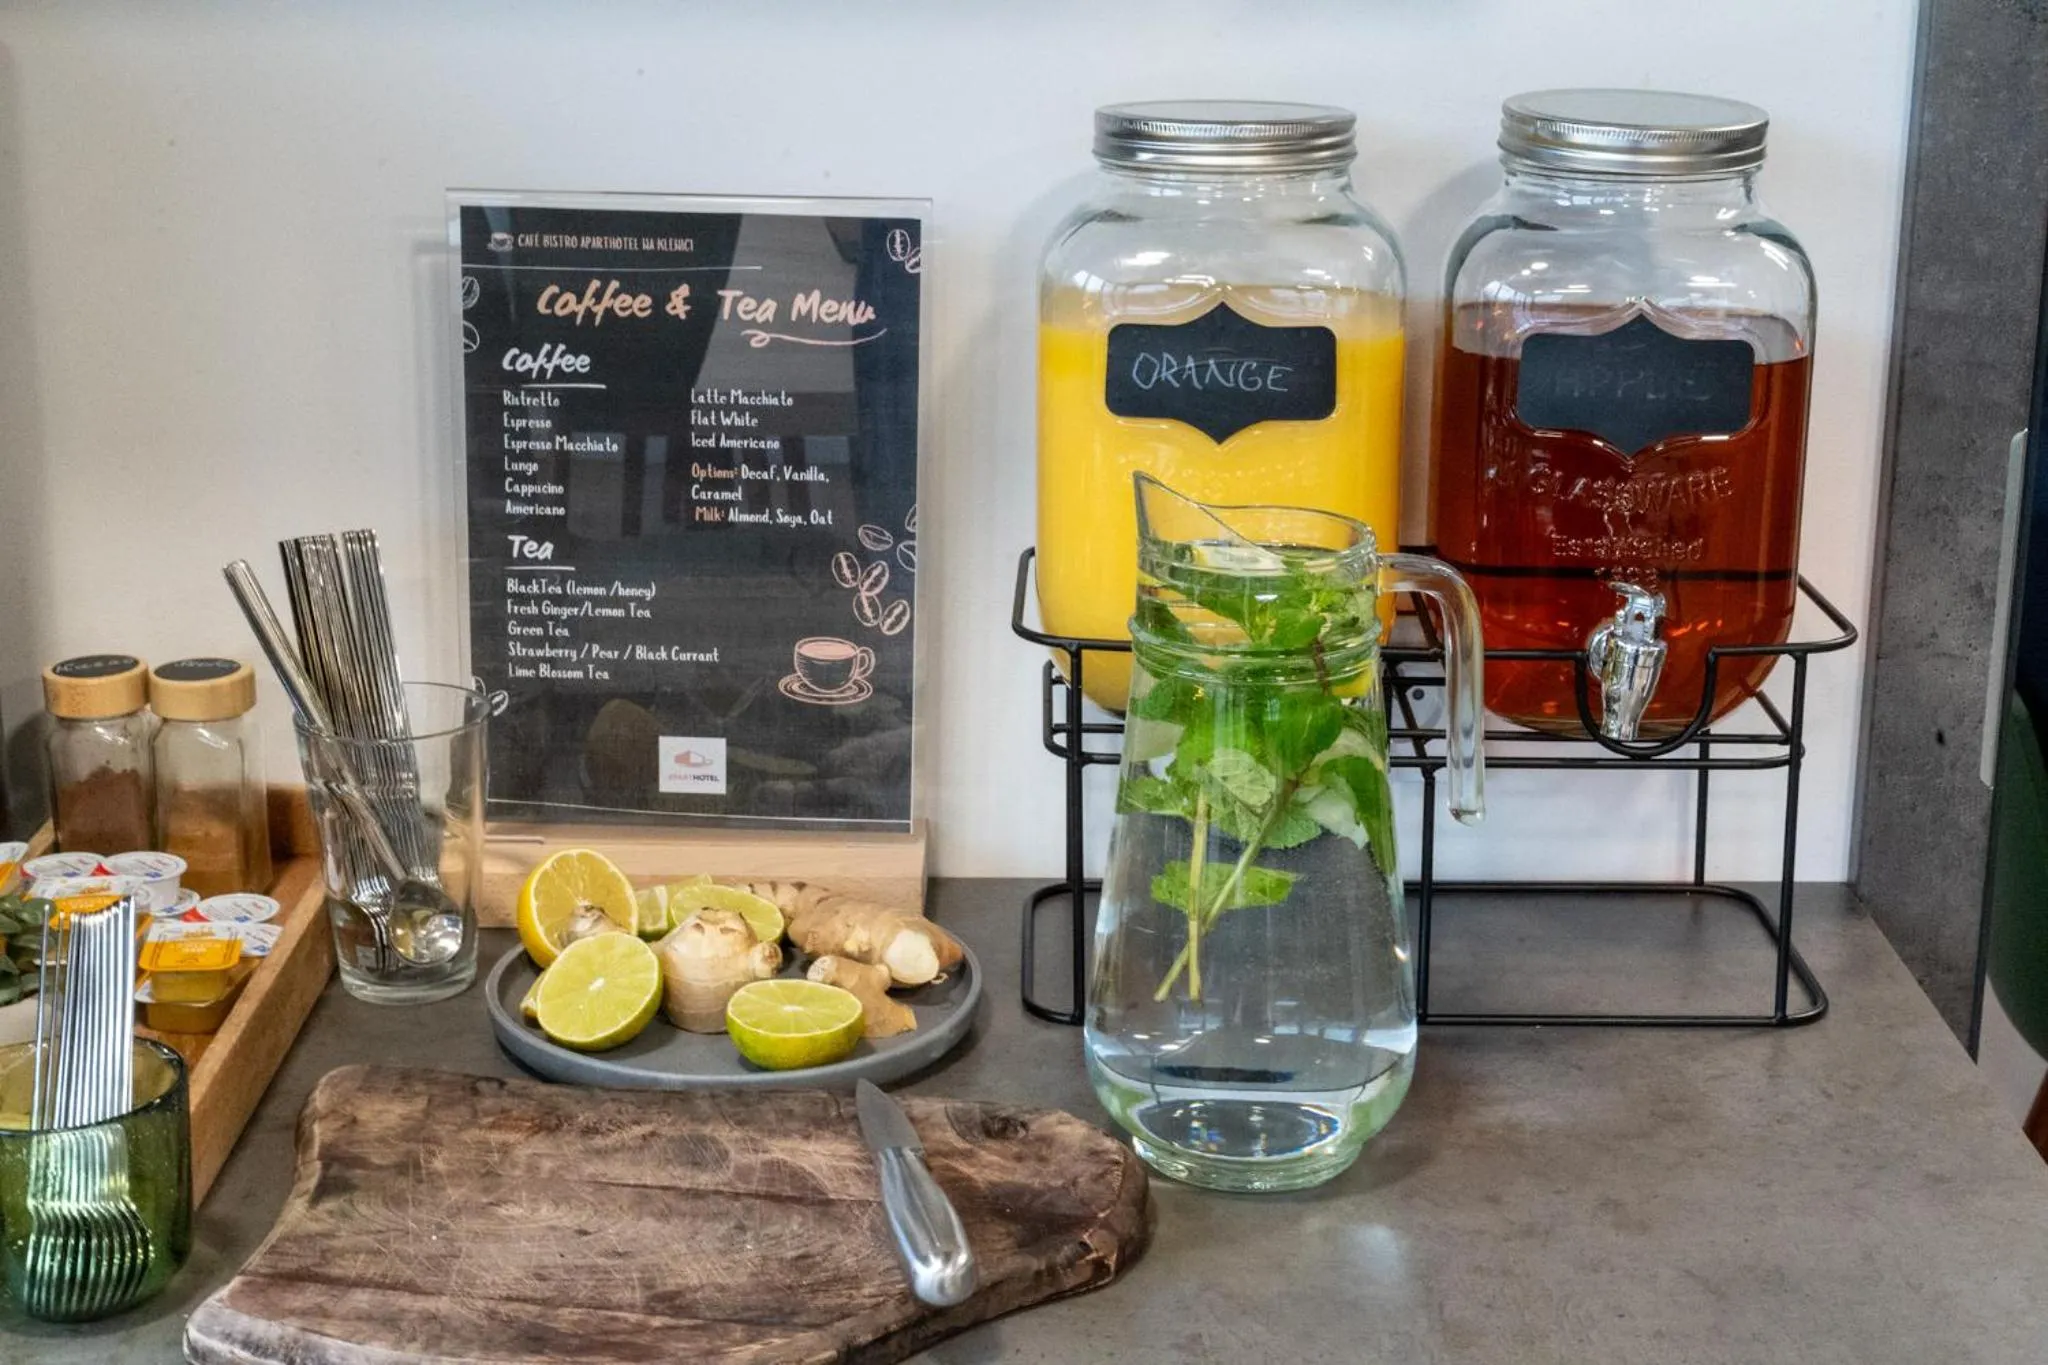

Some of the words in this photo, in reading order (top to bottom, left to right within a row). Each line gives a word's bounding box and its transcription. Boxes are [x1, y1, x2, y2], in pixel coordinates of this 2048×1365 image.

[543, 233, 577, 249] BISTRO
[580, 235, 639, 250] APARTHOTEL
[537, 279, 652, 327] Coffee
[665, 283, 692, 320] &
[717, 289, 776, 323] Tea
[790, 289, 876, 326] Menu
[502, 343, 591, 380] Coffee
[1132, 351, 1294, 392] ORANGE
[502, 389, 560, 407] Ristretto
[691, 387, 727, 405] Latte
[730, 388, 794, 406] Macchiato
[503, 411, 552, 431] Espresso
[690, 409, 717, 426] Flat
[720, 410, 759, 427] White
[503, 433, 552, 453] Espresso
[555, 435, 619, 453] Macchiato
[691, 431, 717, 448] Iced
[719, 432, 780, 449] Americano
[504, 455, 539, 475] Lungo
[691, 462, 739, 482] Options:
[741, 463, 781, 482] Decaf,
[783, 465, 830, 483] Vanilla,
[505, 477, 565, 497] Cappucino
[691, 484, 743, 501] Caramel
[505, 500, 566, 516] Americano
[694, 506, 725, 521] Milk:
[728, 507, 773, 525] Almond,
[776, 508, 807, 528] Soya,
[810, 509, 833, 525] Oat
[507, 535, 554, 560] Tea
[507, 598, 539, 615] Fresh
[629, 602, 652, 619] Tea
[508, 621, 544, 636] Green
[547, 621, 570, 638] Tea
[508, 641, 577, 662] Strawberry
[592, 644, 619, 660] Pear
[635, 645, 668, 661] Black
[671, 647, 720, 663] Currant
[508, 662, 536, 678] Lime
[538, 662, 584, 679] Blossom
[587, 664, 610, 680] Tea
